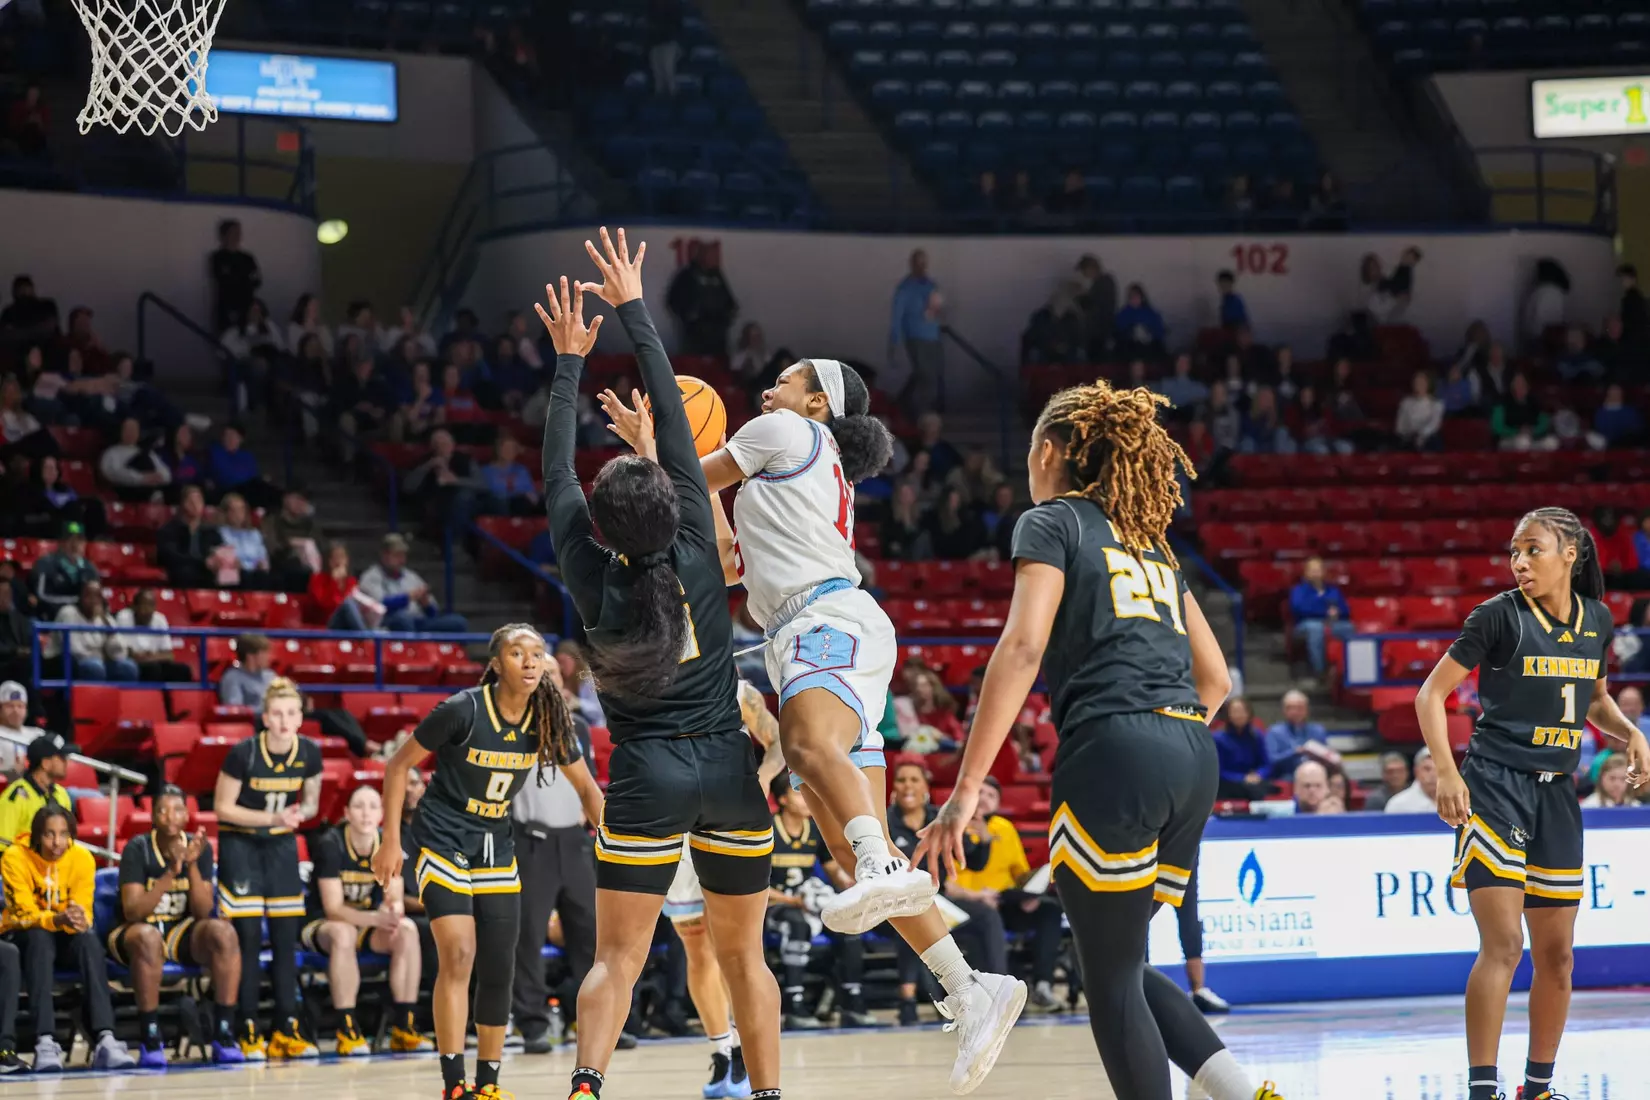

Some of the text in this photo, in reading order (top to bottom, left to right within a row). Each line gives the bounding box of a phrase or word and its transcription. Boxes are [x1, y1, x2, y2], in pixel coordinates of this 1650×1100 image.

[1545, 86, 1647, 124] Super 1
[1230, 244, 1290, 275] 102
[1101, 547, 1187, 636] 24
[1560, 683, 1576, 723] 1
[1532, 726, 1583, 750] STAT
[486, 771, 515, 801] 0
[466, 797, 511, 818] STAT
[1374, 864, 1614, 918] PROE
[1202, 906, 1314, 934] ouisiana
